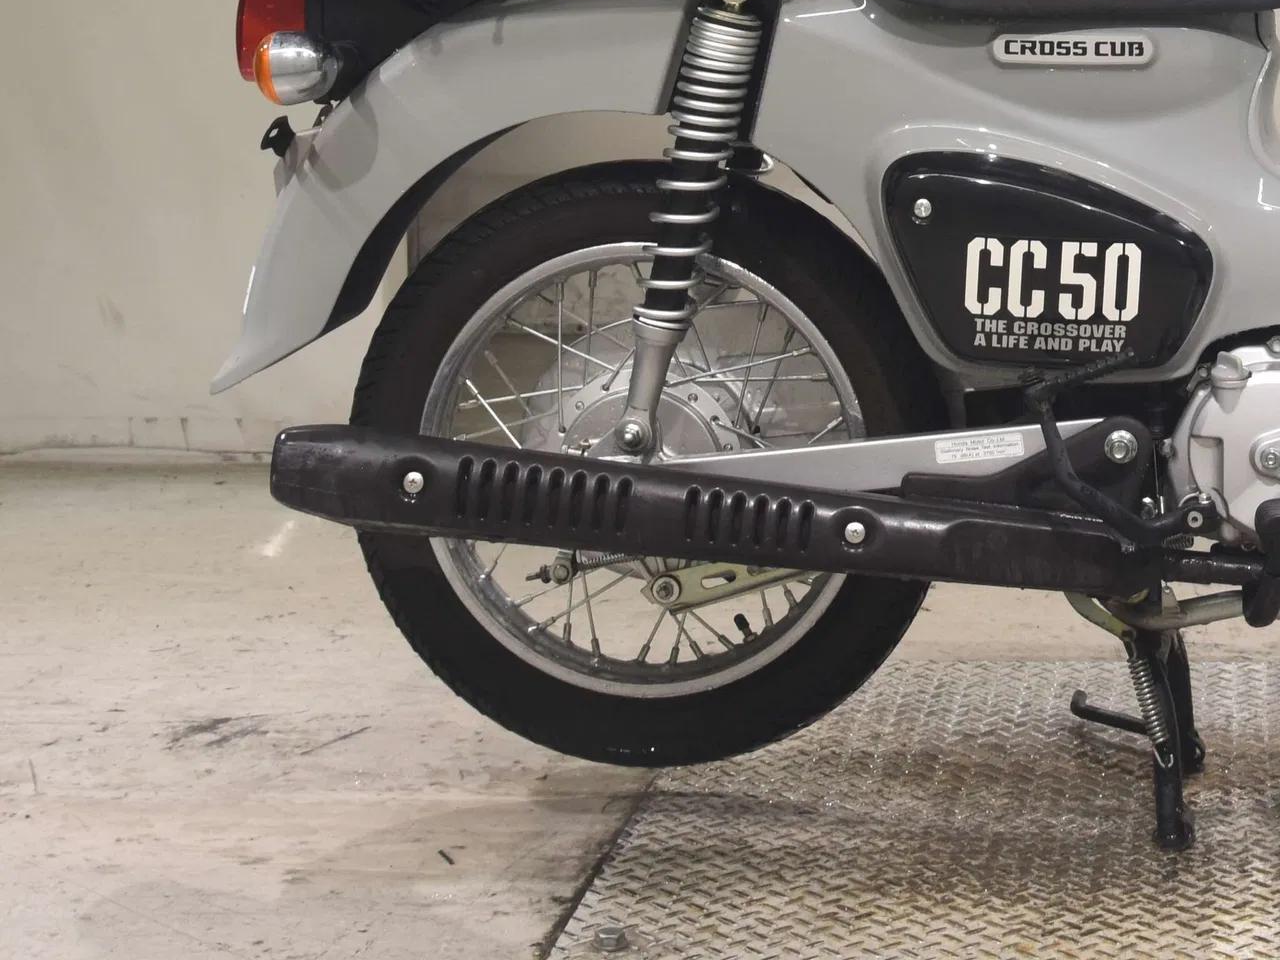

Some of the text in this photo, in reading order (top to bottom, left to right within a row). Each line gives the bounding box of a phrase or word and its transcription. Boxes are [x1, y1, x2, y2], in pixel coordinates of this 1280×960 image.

[1004, 39, 1144, 57] CROSS CUB
[974, 318, 1127, 338] THE CROSSOVER
[974, 333, 1125, 353] A LIFE AND PLAY
